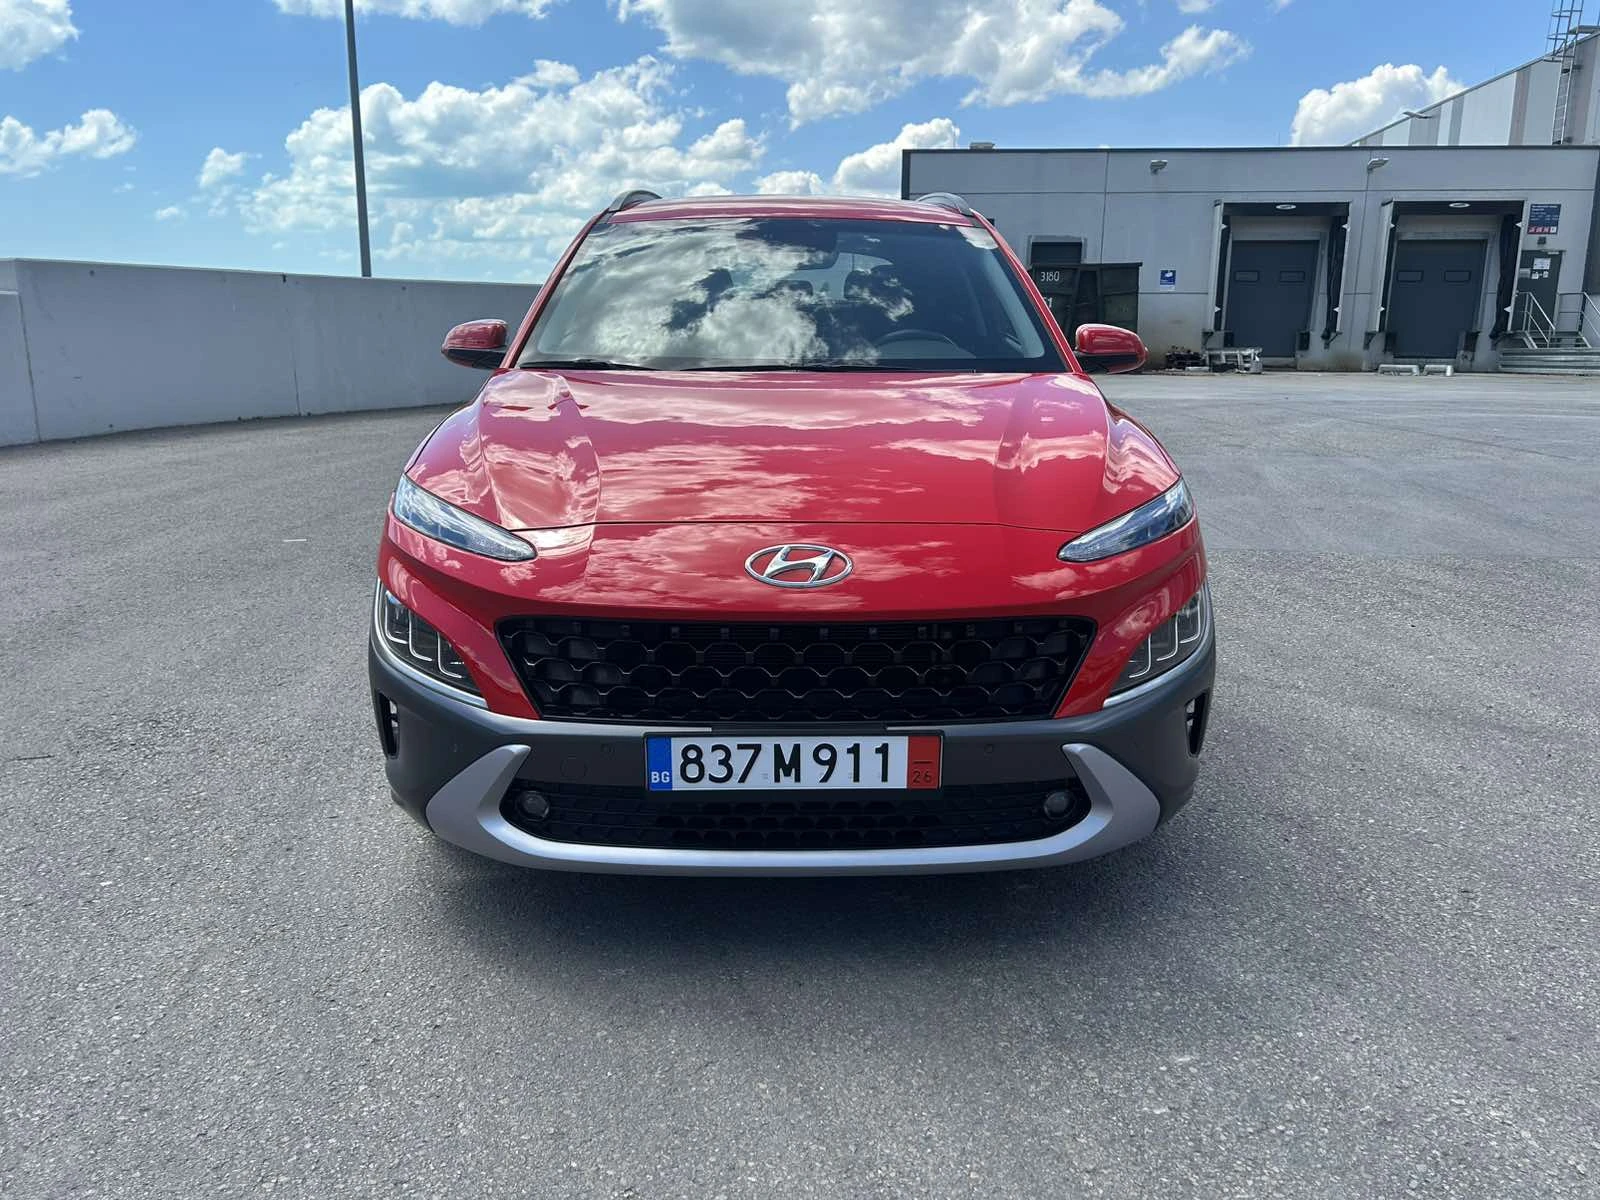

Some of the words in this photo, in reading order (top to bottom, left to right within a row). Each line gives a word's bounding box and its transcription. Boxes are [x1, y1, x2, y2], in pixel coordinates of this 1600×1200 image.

[1041, 271, 1060, 282] 3180
[679, 743, 762, 784] 837
[812, 742, 890, 783] 911
[651, 771, 671, 783] BG
[912, 769, 932, 784] 26
